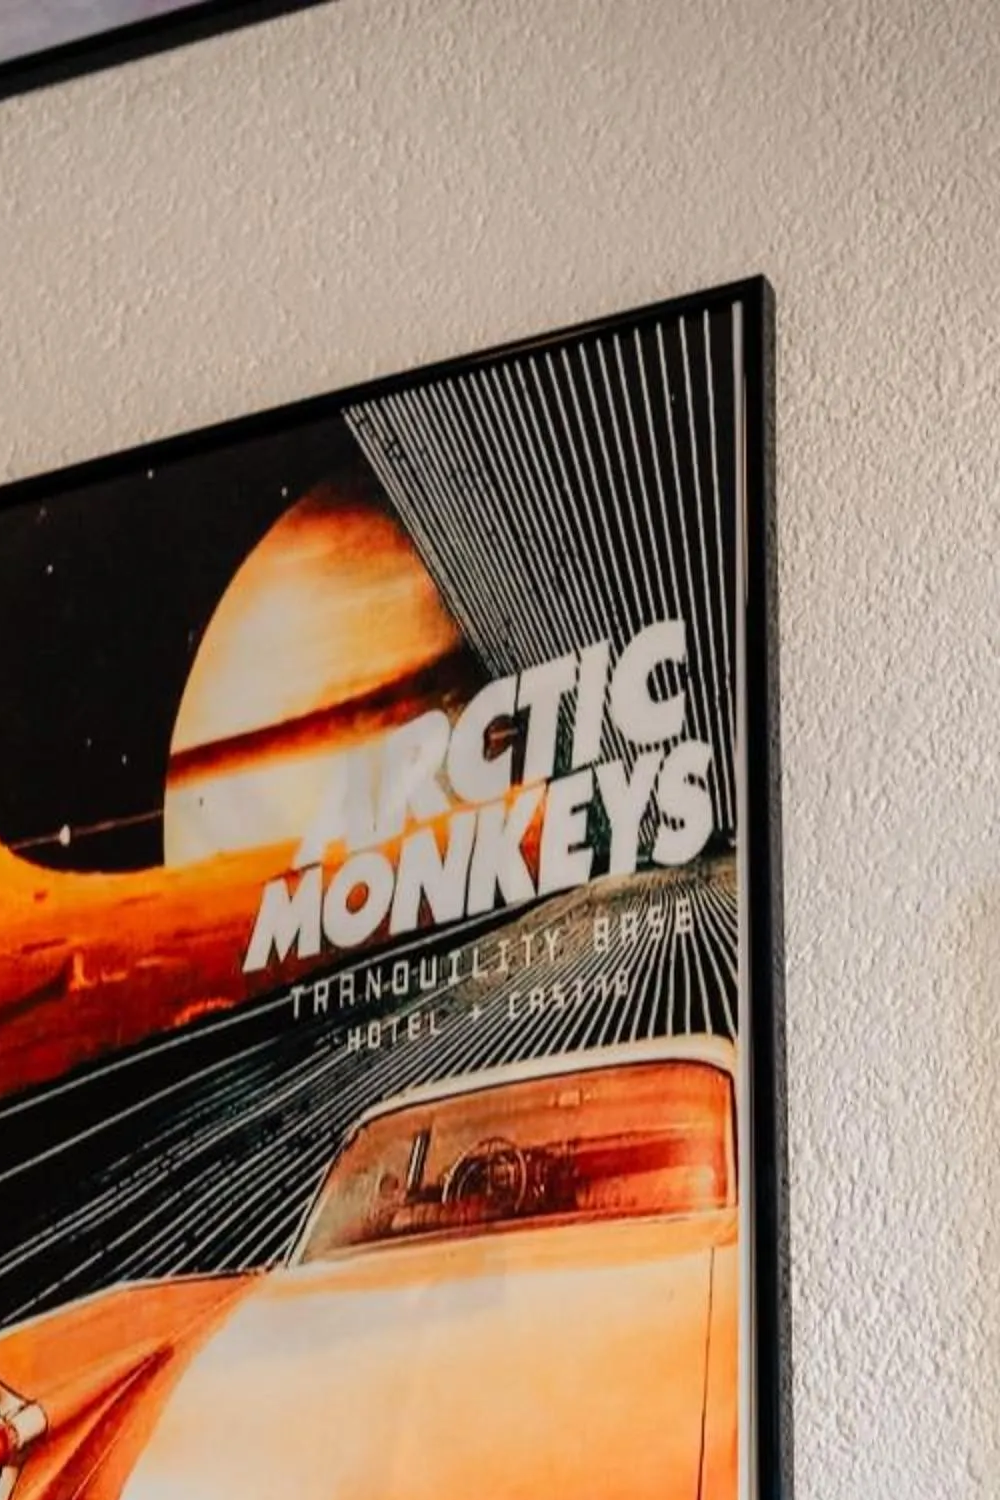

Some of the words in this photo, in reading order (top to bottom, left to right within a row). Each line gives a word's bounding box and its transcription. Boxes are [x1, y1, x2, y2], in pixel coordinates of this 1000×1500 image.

[293, 617, 687, 869] ARCTIC
[242, 737, 714, 974] MONKEYS
[290, 927, 562, 1020] TRANQUILITY
[594, 896, 692, 952] BASE
[348, 1009, 441, 1052] HOTEL
